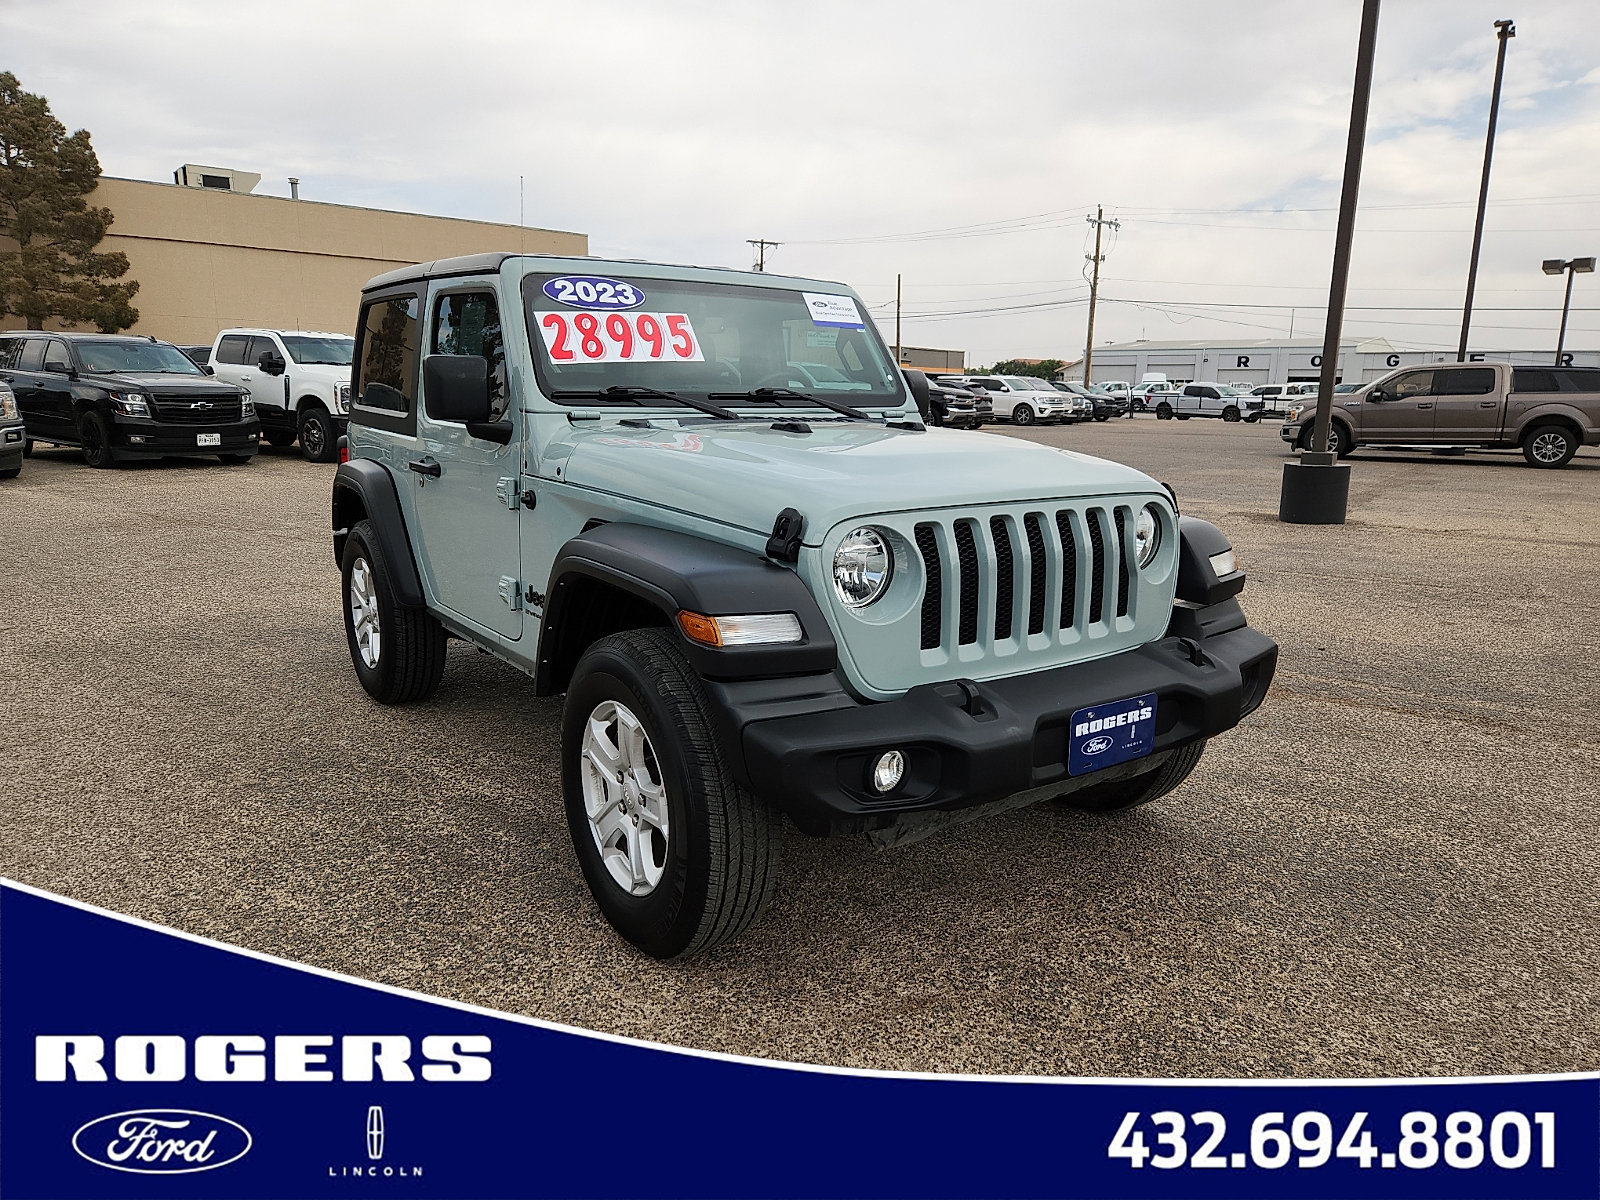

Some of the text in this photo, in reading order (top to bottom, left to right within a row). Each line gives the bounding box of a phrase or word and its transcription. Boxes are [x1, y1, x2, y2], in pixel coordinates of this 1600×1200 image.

[554, 279, 637, 305] 2023
[543, 313, 696, 361] 28995
[1075, 706, 1152, 738] ROGERS
[1086, 737, 1109, 753] Ford
